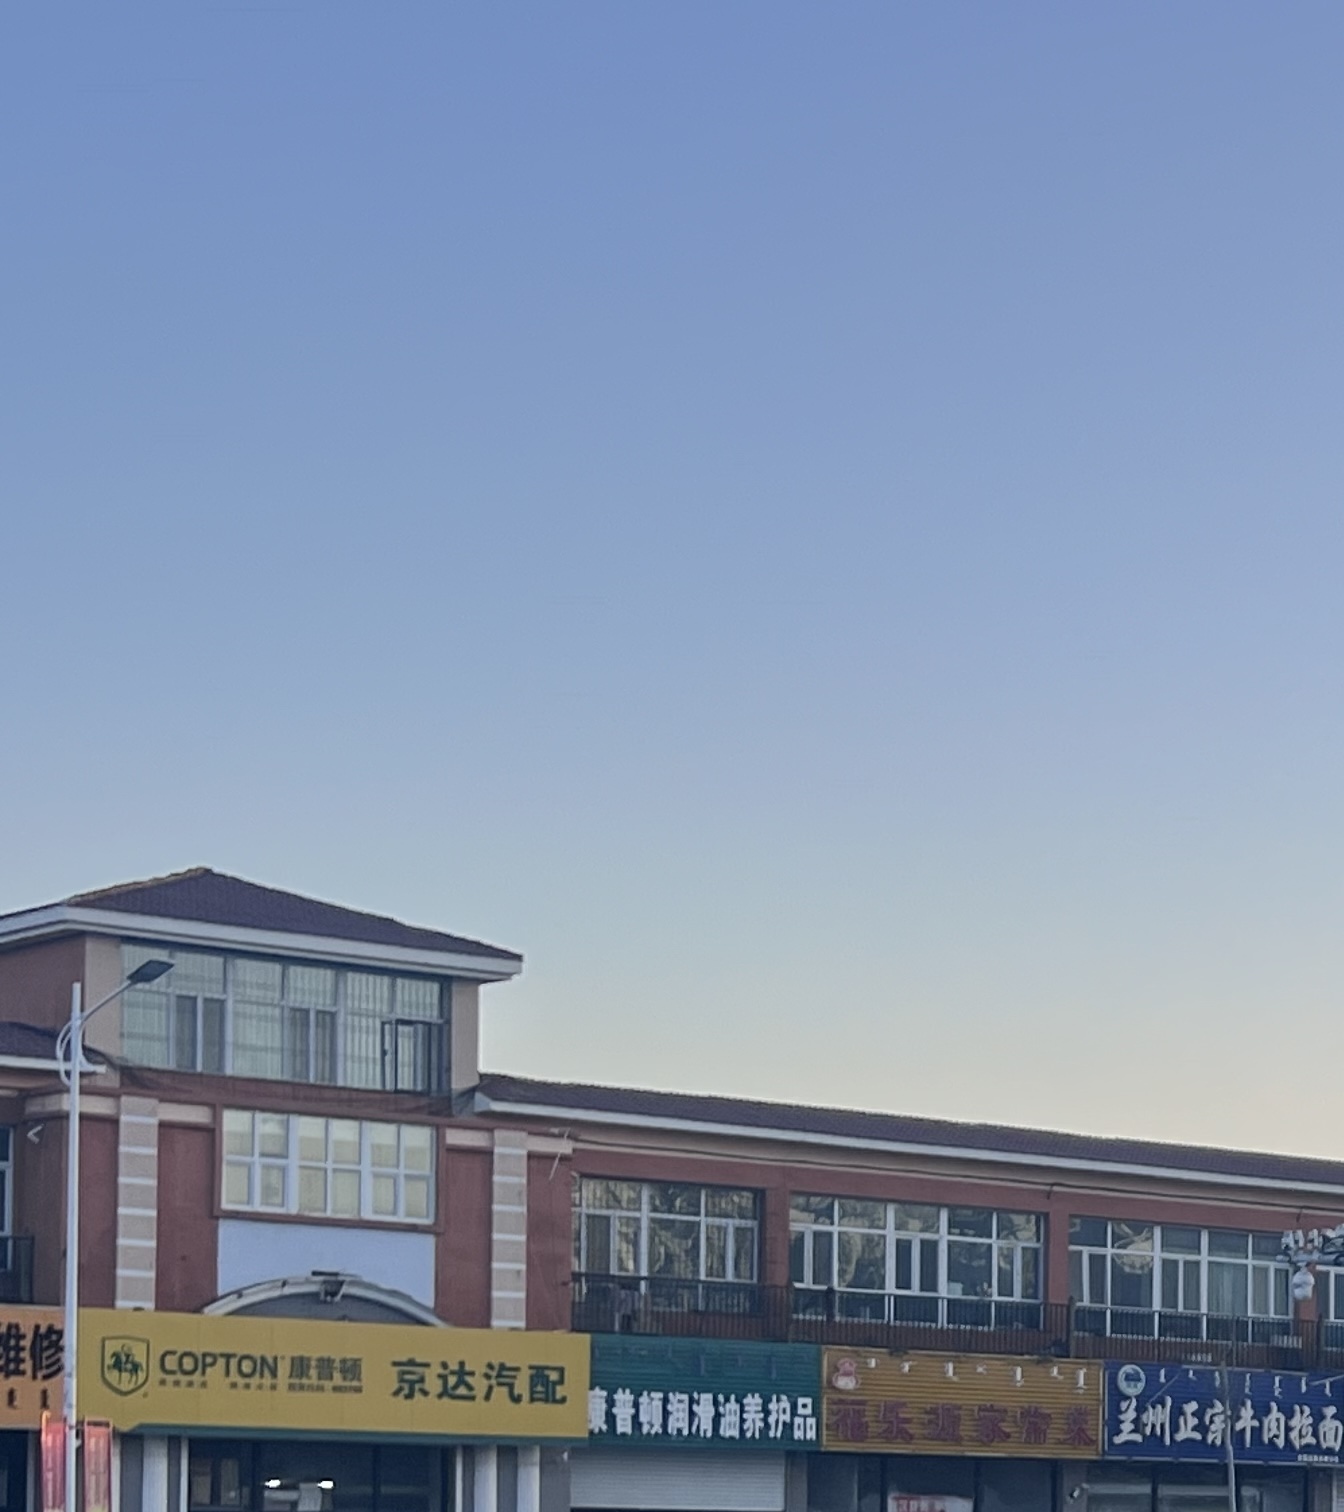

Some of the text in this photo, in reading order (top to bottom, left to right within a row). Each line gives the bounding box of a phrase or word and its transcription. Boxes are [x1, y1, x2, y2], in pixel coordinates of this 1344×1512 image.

[159, 1349, 363, 1382] COPTON 康普顿
[391, 1358, 567, 1405] 京达汽配
[588, 1385, 816, 1441] 康普顿润滑油养护品
[1112, 1395, 1344, 1452] 兰州正宗牛肉拉面
